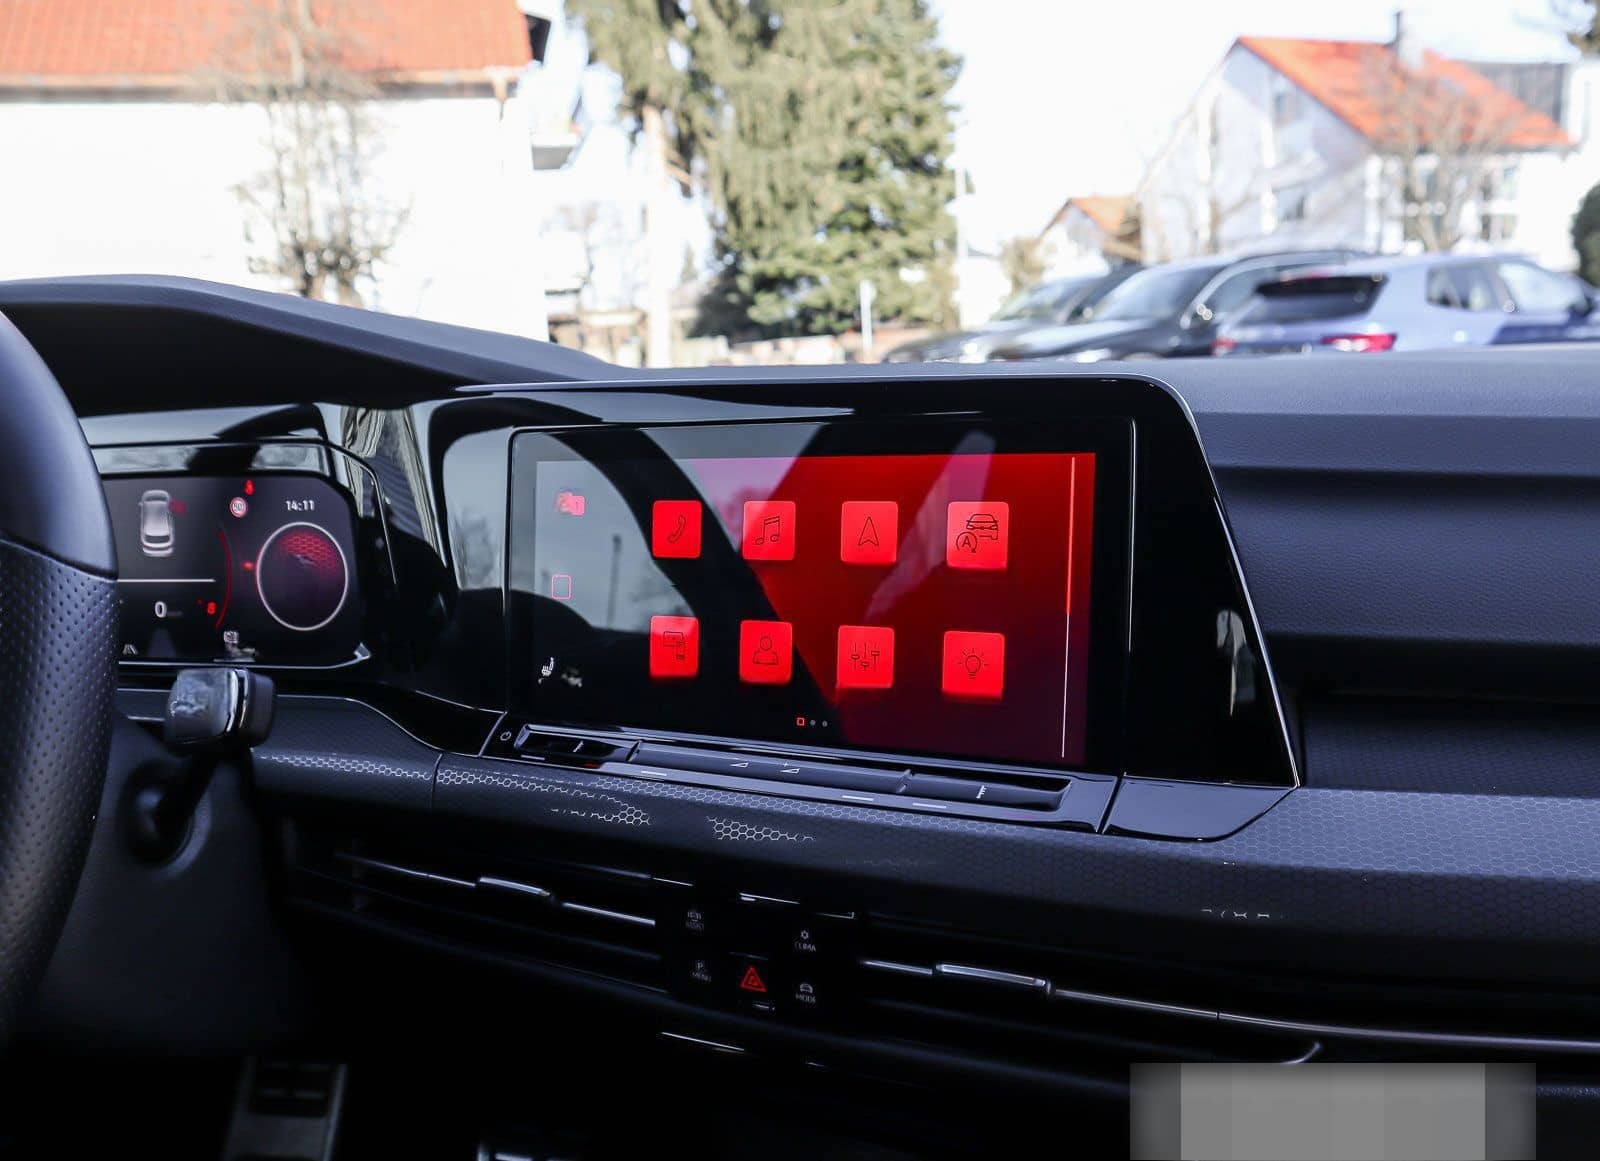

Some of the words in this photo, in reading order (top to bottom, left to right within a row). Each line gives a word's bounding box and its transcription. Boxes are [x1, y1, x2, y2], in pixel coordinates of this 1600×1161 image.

[285, 499, 315, 511] 14:11
[962, 536, 972, 548] A
[154, 601, 167, 618] 0
